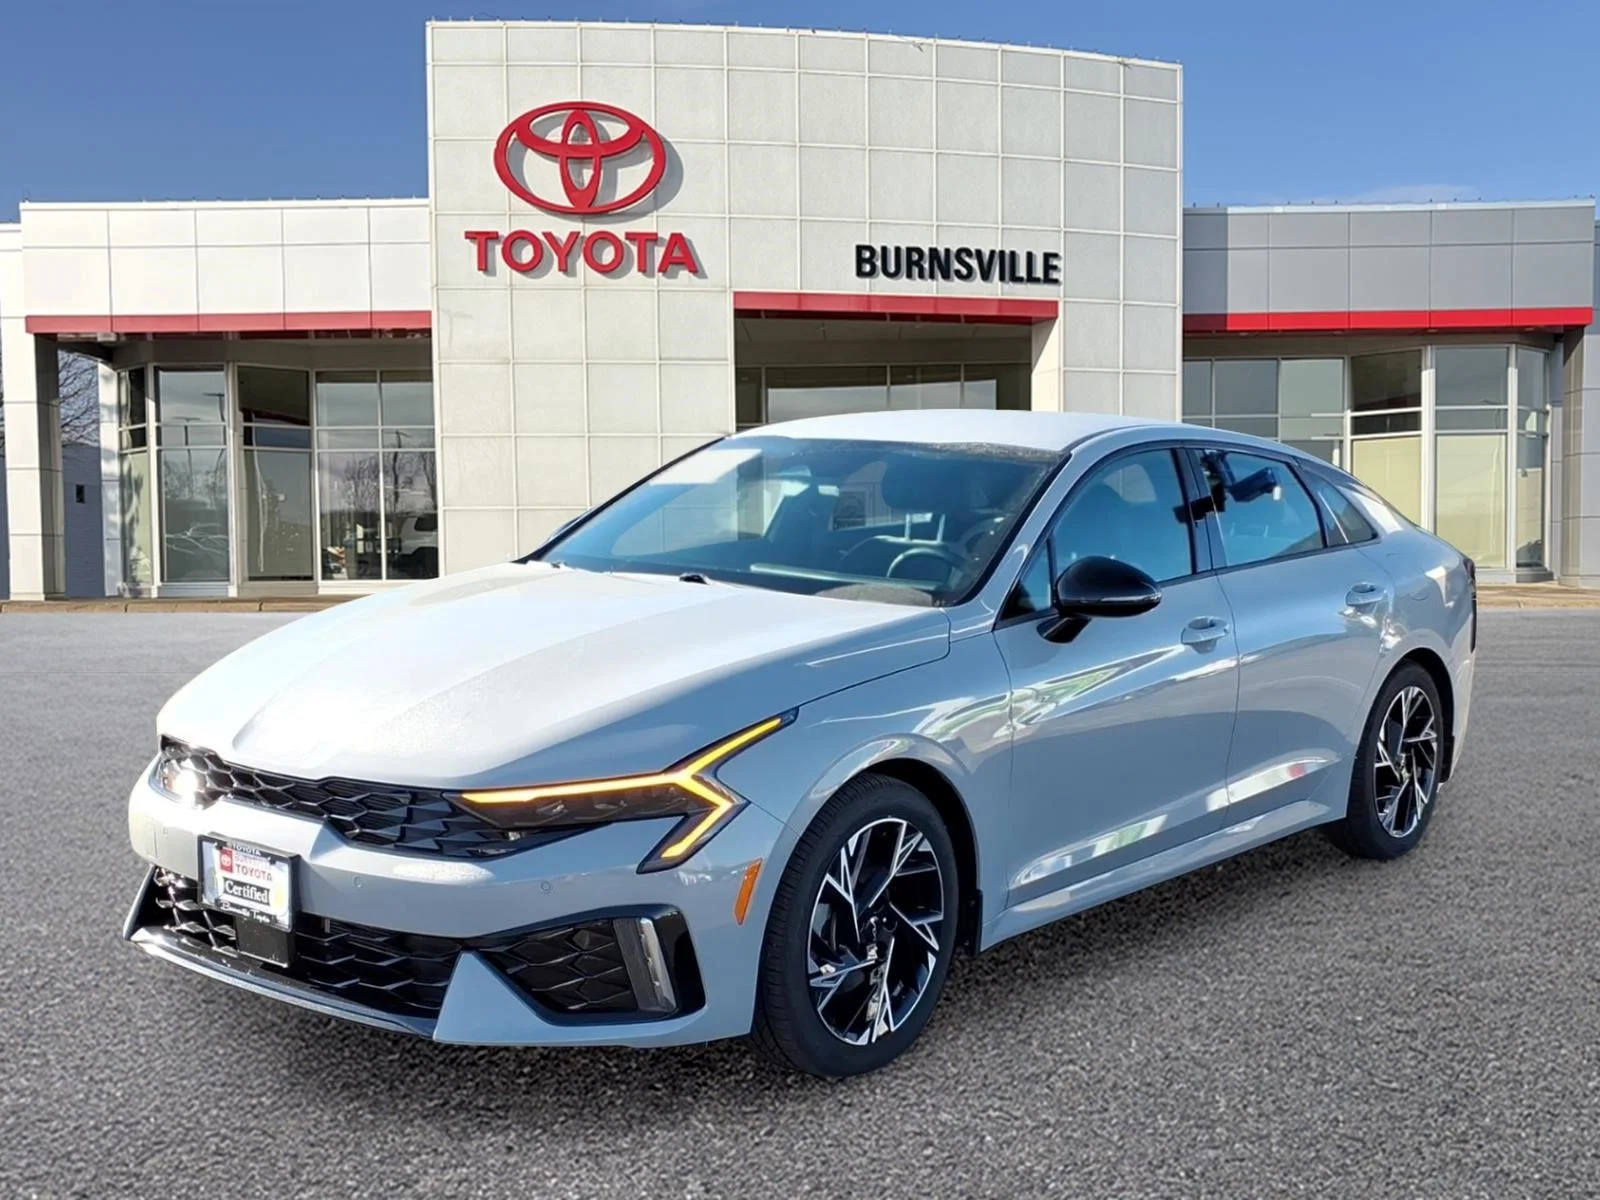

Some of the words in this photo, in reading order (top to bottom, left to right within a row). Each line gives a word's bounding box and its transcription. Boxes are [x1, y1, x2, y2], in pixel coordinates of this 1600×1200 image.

[464, 229, 697, 273] TOYOTA
[855, 244, 1062, 284] BURNSVILLE
[235, 864, 273, 881] TOYOTA
[225, 880, 268, 904] Certified
